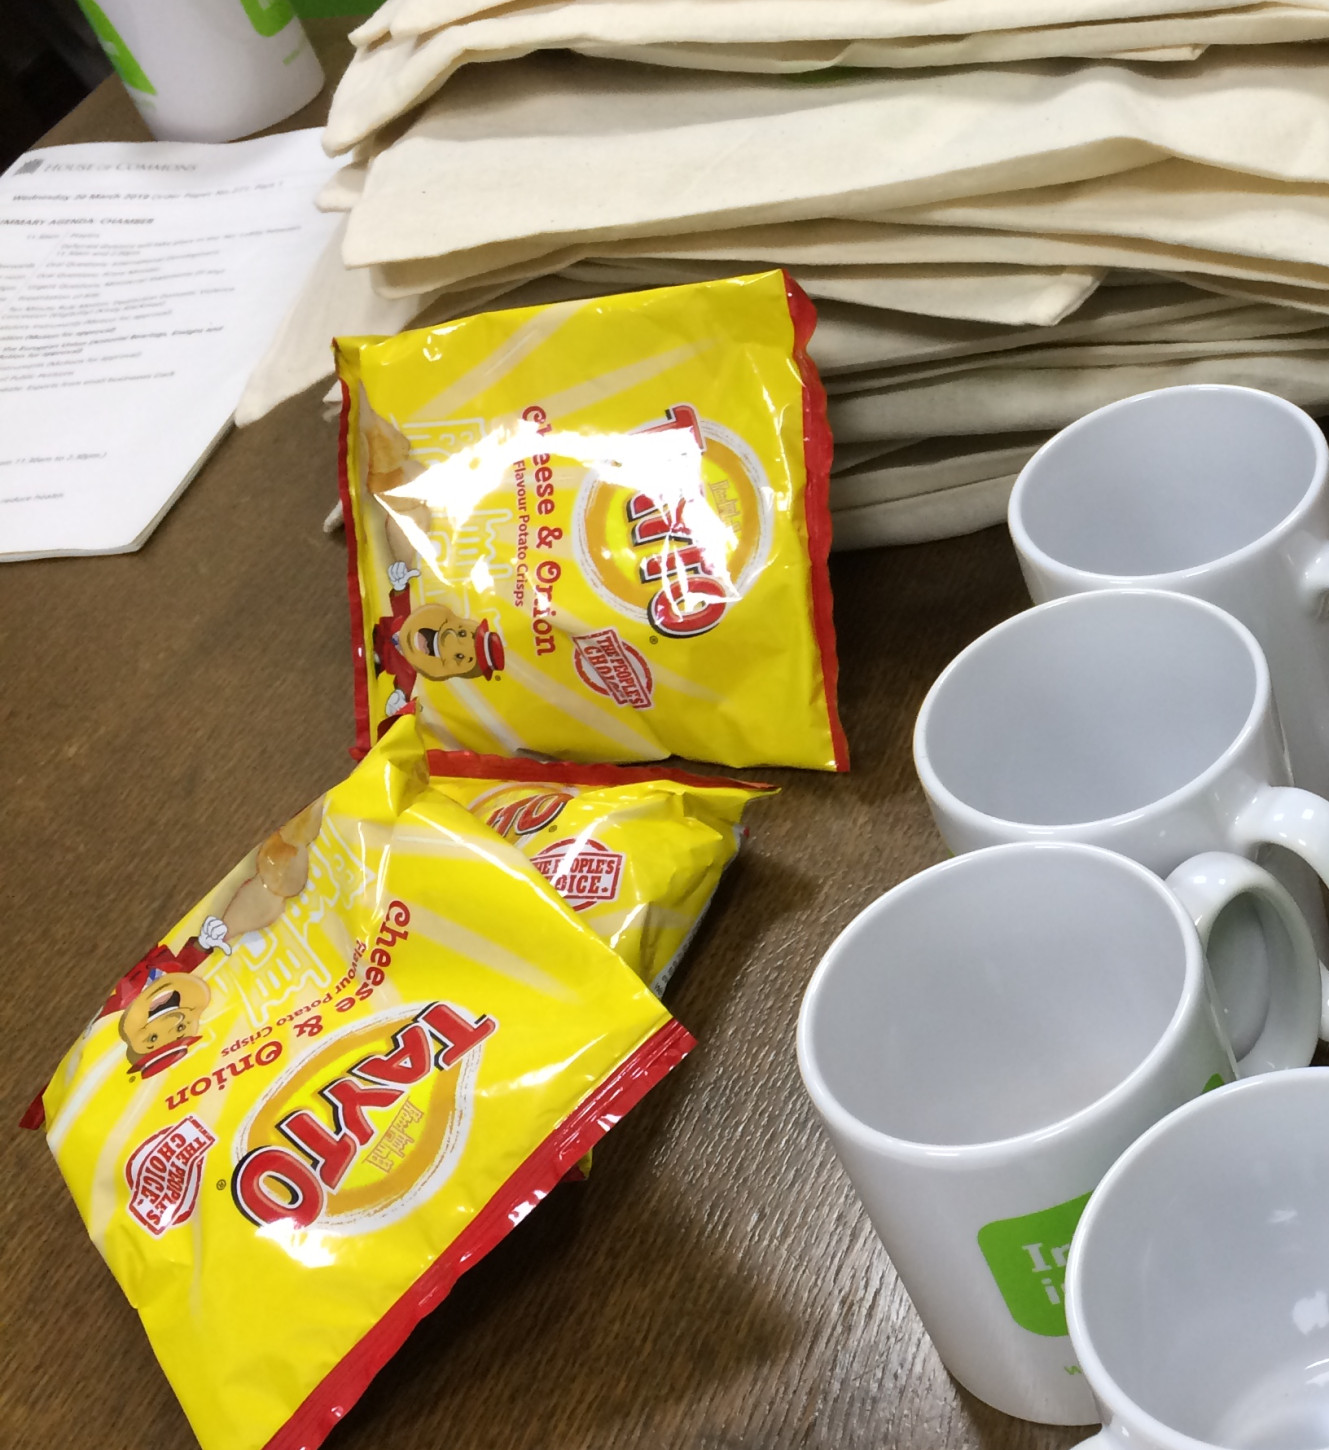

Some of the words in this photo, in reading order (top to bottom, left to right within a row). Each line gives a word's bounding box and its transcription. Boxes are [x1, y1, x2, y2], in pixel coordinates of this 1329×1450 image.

[44, 162, 94, 172] HOUSE
[114, 162, 198, 172] COMMONS
[12, 193, 70, 202] Wednesday
[88, 191, 121, 200] March
[99, 216, 155, 225] CHAMBER
[522, 405, 556, 515] Ceese
[513, 460, 528, 512] Flavour
[516, 514, 530, 561] Potato
[536, 525, 563, 549] &
[513, 561, 529, 607] Crisps
[552, 857, 616, 875] OPLE'S
[335, 900, 411, 1013] Cheese
[335, 939, 367, 995] Flavour
[276, 991, 334, 1027] Potato
[293, 1014, 323, 1038] &
[221, 1026, 273, 1057] Crisps
[165, 1040, 283, 1111] Onion
[231, 1001, 500, 1230] TAYTO
[140, 1133, 187, 1205] CHOICE
[175, 1137, 207, 1167] THE
